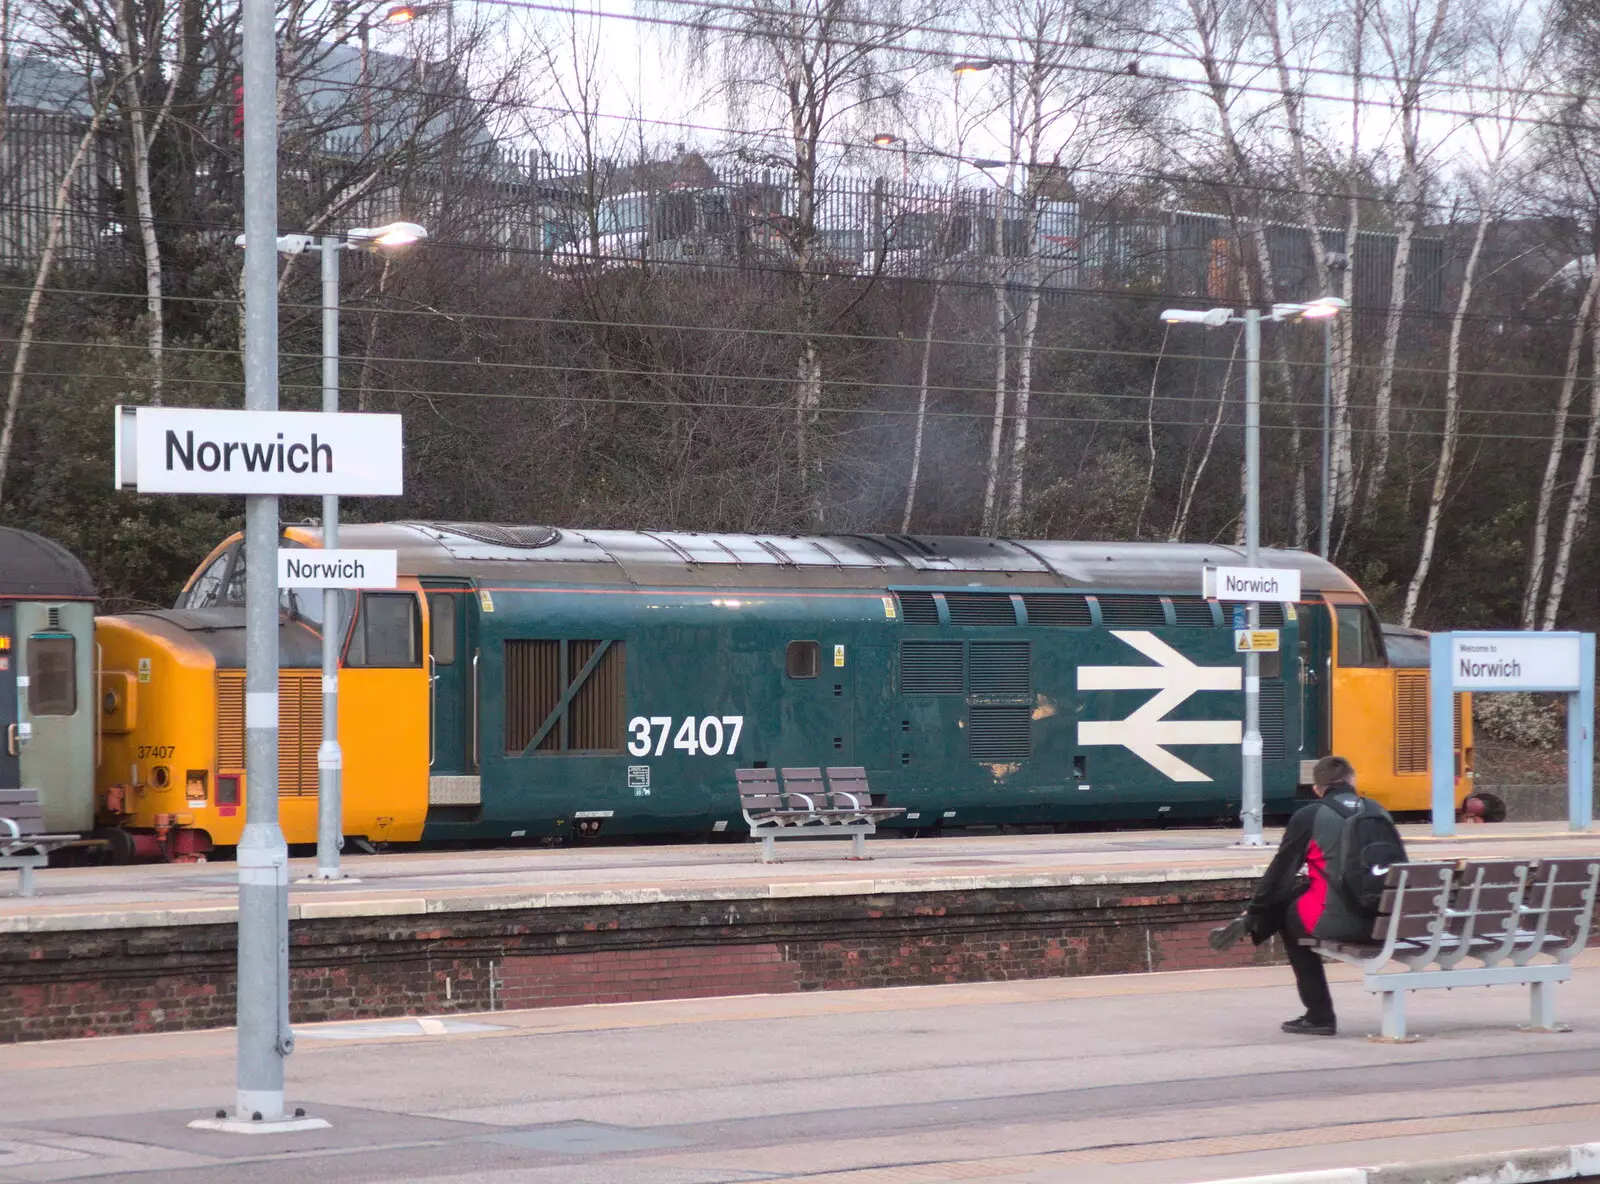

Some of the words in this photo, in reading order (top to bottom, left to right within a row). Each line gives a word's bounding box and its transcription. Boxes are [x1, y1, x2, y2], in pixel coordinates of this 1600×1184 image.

[165, 430, 333, 473] Norwich
[286, 558, 365, 579] Norwich
[1226, 575, 1279, 593] Norwich
[1460, 644, 1489, 652] Welcome
[1490, 644, 1497, 652] to
[1460, 658, 1521, 677] Norwich
[627, 715, 744, 757] 37407
[137, 746, 176, 759] 37407
